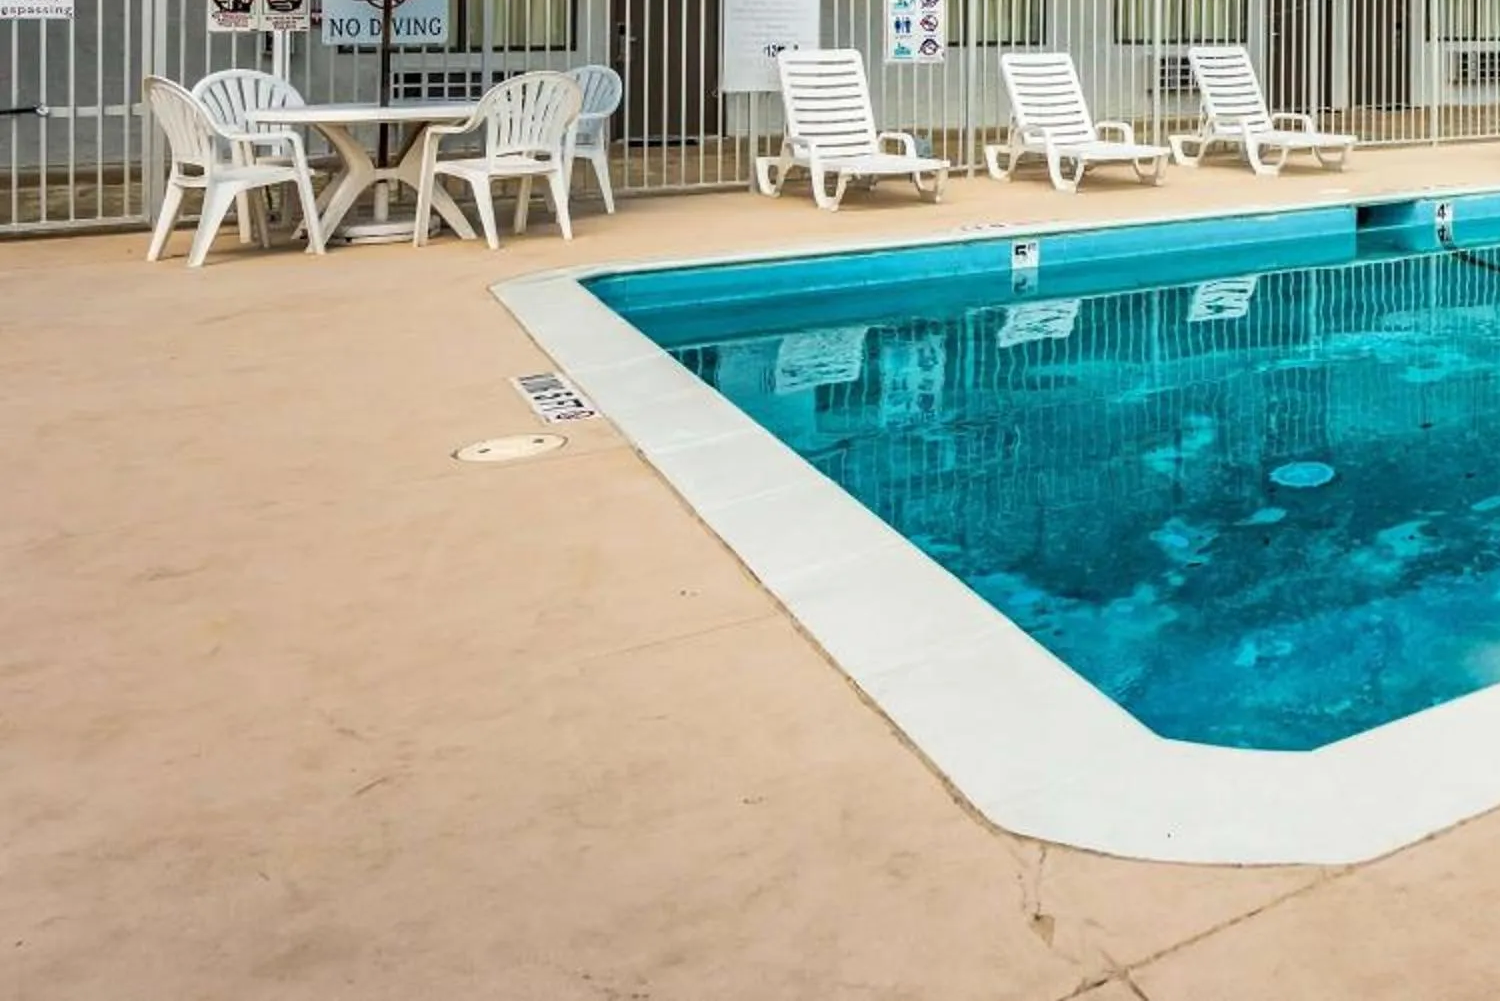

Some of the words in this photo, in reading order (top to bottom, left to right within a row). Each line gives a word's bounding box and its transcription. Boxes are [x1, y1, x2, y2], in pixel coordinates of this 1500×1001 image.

[329, 18, 361, 37] NO
[368, 17, 441, 37] DVING
[1437, 202, 1447, 220] 4
